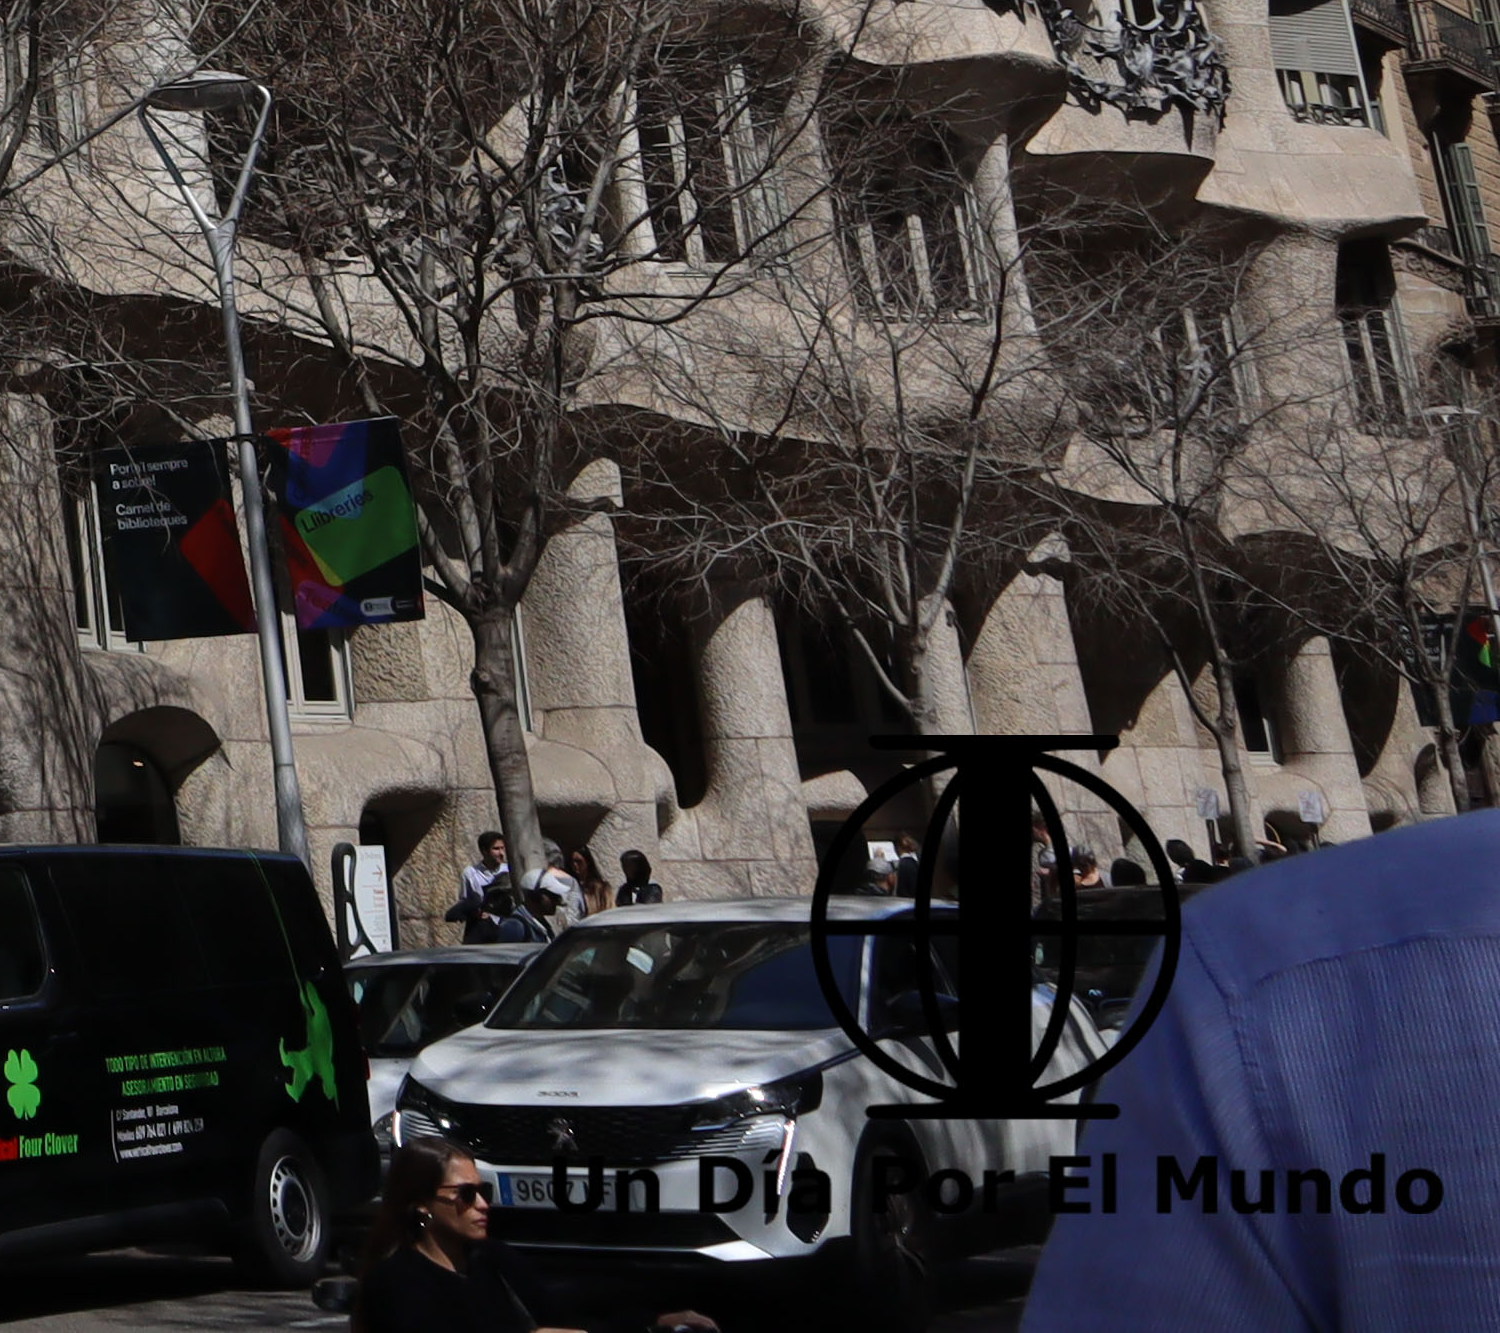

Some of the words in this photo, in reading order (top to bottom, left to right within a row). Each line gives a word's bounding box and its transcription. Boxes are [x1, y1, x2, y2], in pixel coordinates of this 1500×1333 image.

[146, 458, 189, 473] sempre
[112, 480, 121, 491] a
[115, 502, 155, 516] Carnet
[156, 500, 172, 512] de
[300, 489, 375, 534] Llibreries
[116, 514, 189, 531] biblioteques
[105, 1056, 124, 1074] TODO
[124, 1054, 140, 1072] TIPO
[121, 1075, 175, 1098] ASESORAMIENTO
[174, 1074, 184, 1092] EN
[19, 1134, 43, 1159] Four
[44, 1131, 80, 1156] Clover
